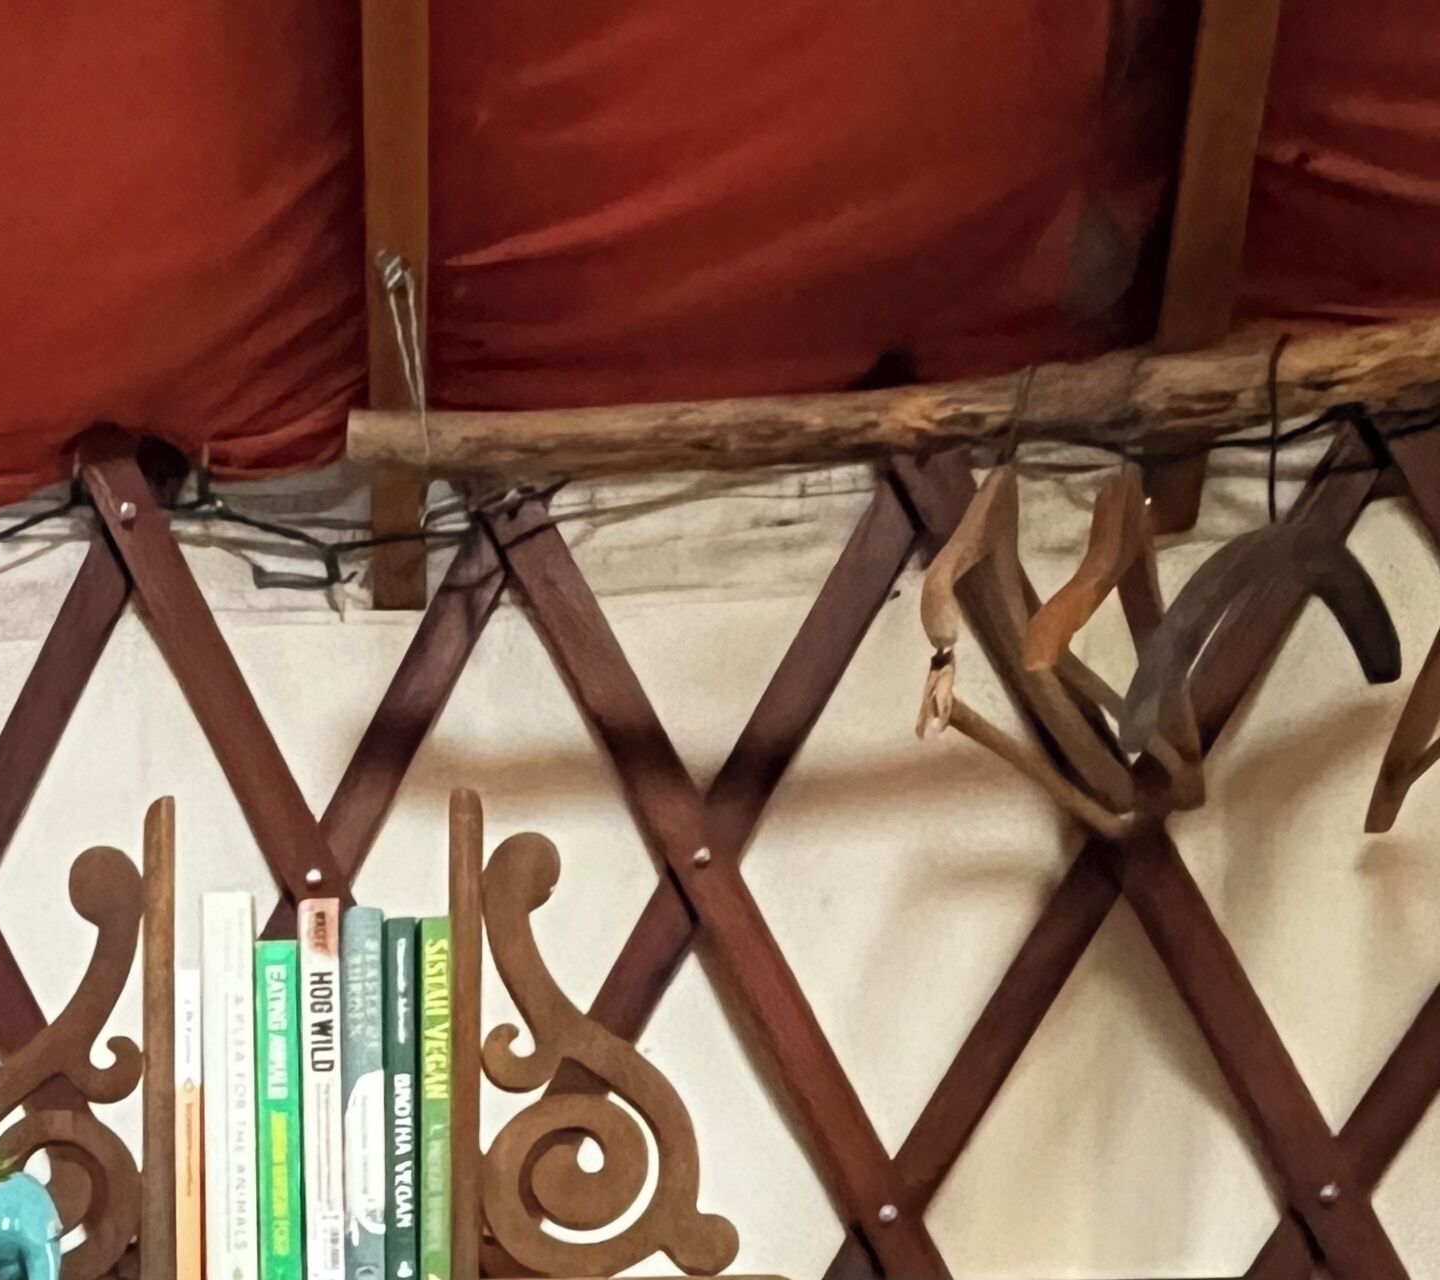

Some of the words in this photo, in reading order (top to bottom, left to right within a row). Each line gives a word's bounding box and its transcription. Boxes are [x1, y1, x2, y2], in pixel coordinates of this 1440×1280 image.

[309, 971, 333, 1013] HOG
[309, 1018, 334, 1072] WILD
[424, 1020, 447, 1099] VEGAN
